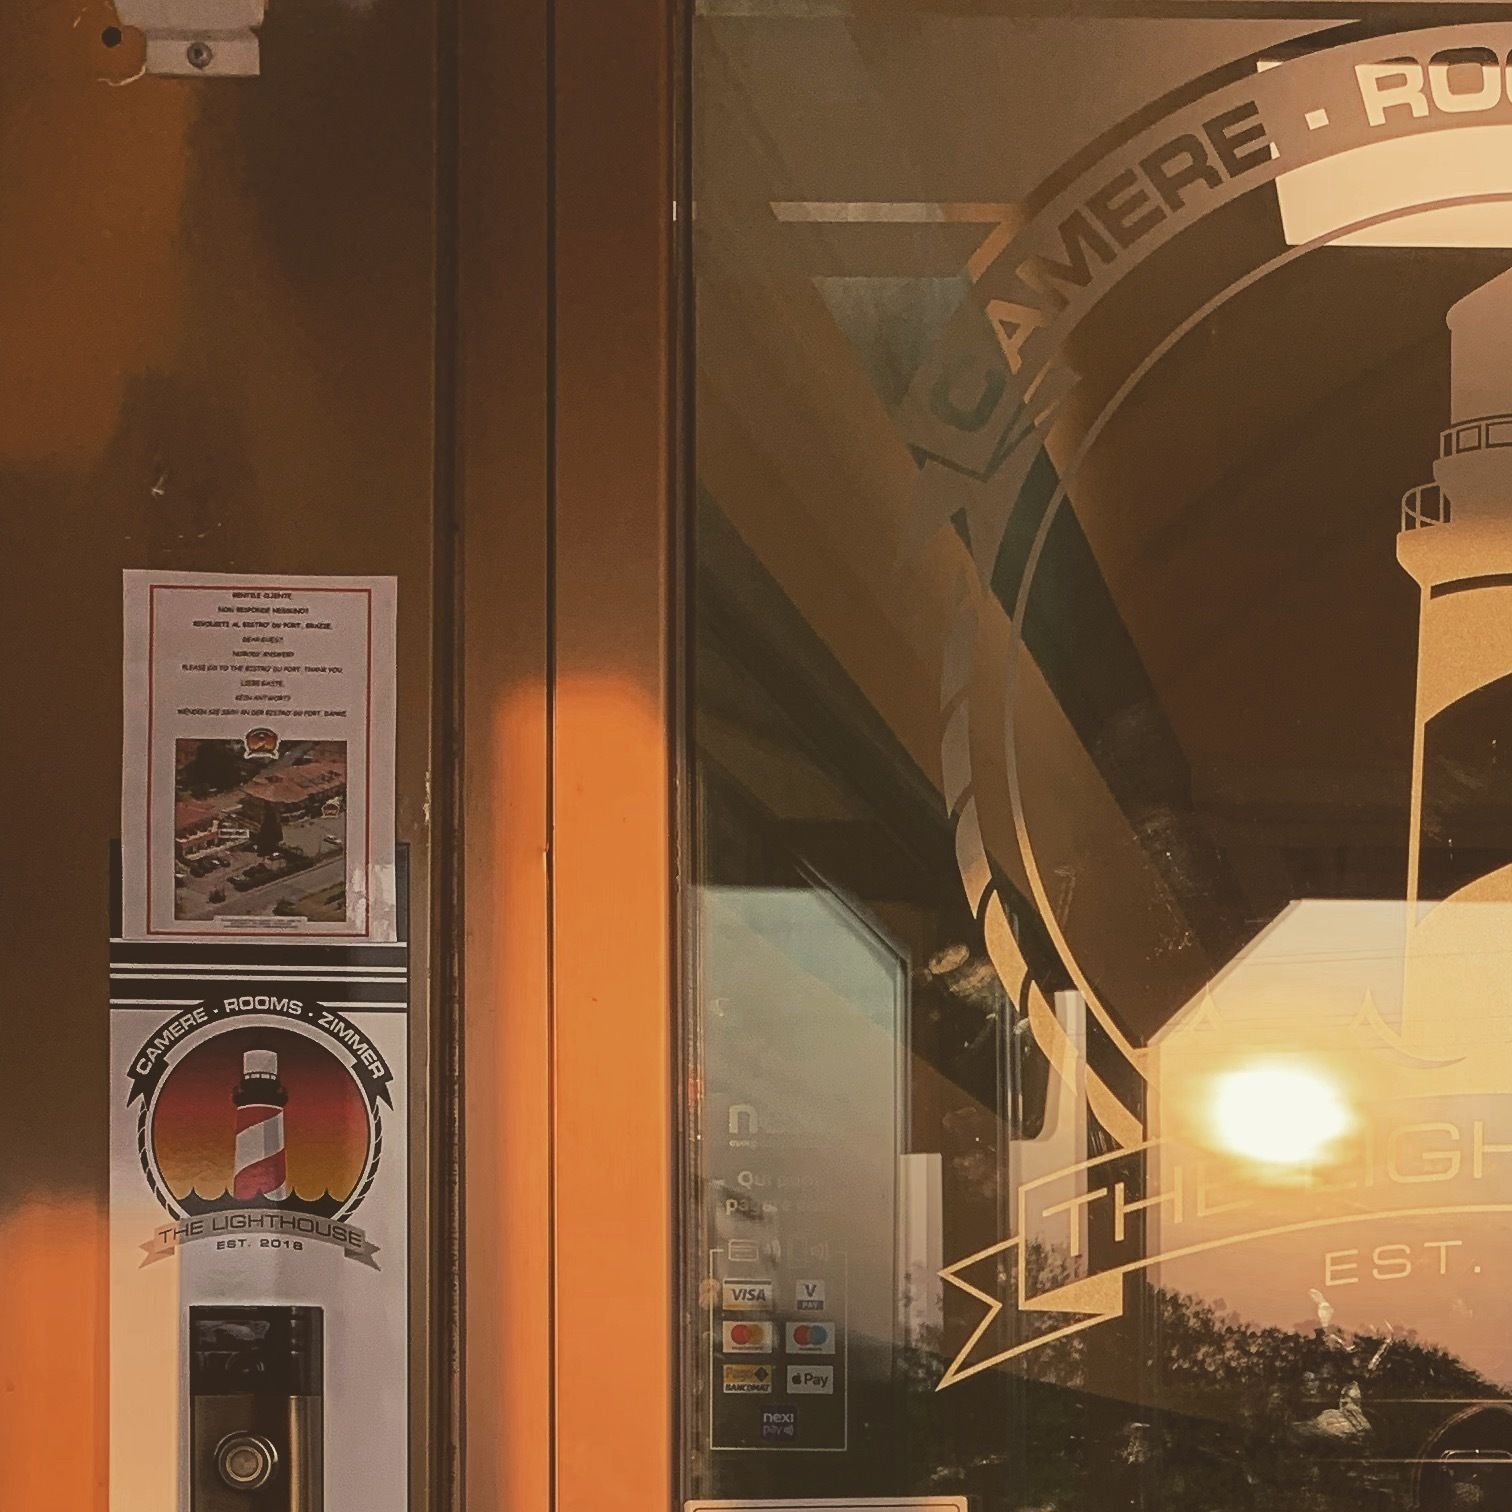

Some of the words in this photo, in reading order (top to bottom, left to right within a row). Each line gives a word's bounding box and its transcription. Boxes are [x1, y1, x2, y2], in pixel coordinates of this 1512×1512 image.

[930, 100, 1280, 431] CAMERE
[135, 1007, 209, 1076] CAMERE
[223, 995, 304, 1016] ROOMS
[317, 1011, 386, 1080] ZIMMER
[158, 1219, 204, 1244] THE
[212, 1214, 363, 1248] LIGHTHOUSE
[216, 1239, 251, 1250] EST.
[260, 1239, 304, 1251] 2018
[1324, 1240, 1481, 1287] EST.
[731, 1288, 767, 1302] VISA
[804, 1373, 829, 1389] Pay
